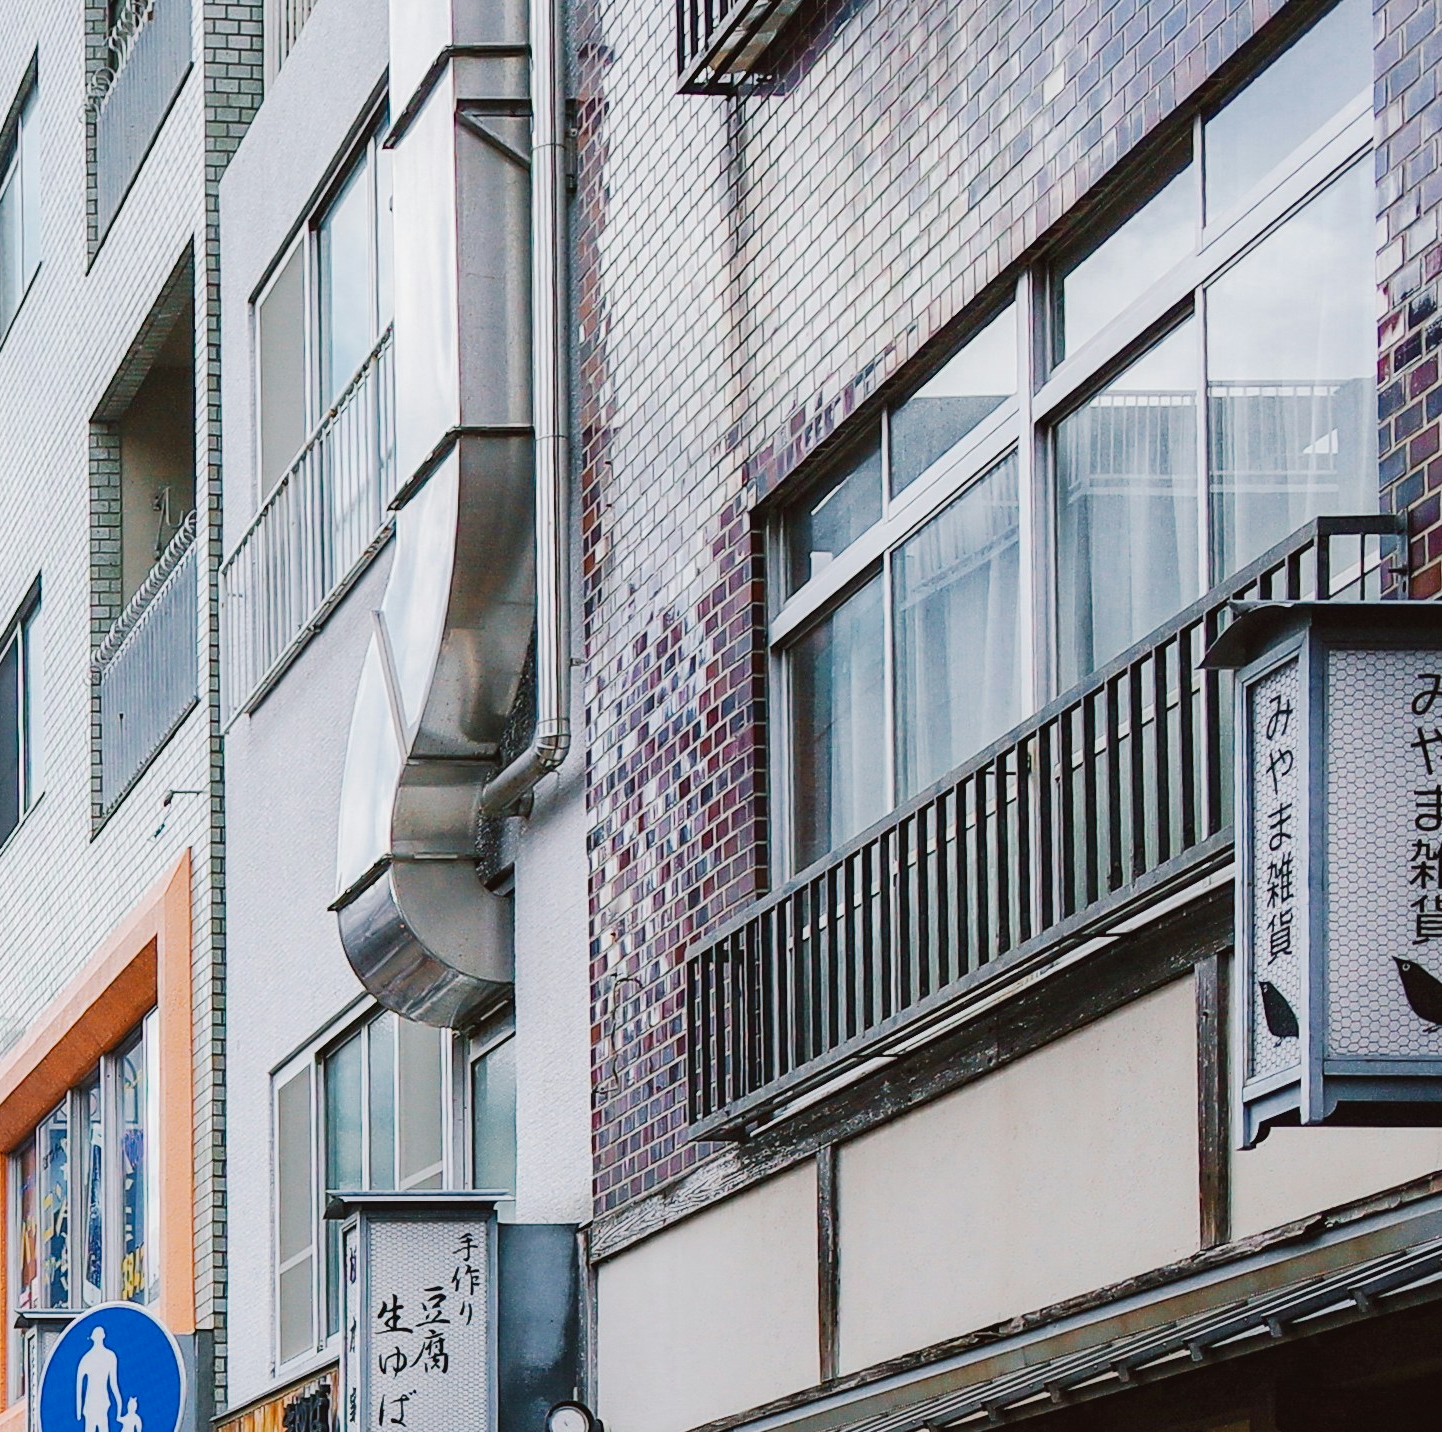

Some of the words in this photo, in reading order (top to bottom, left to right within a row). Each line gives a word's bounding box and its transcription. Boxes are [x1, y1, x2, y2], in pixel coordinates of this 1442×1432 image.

[1266, 695, 1293, 966] みやま雑貨
[411, 1286, 450, 1375] 豆腐
[451, 1232, 481, 1326] 手作り
[374, 1293, 417, 1428] 生ゆば
